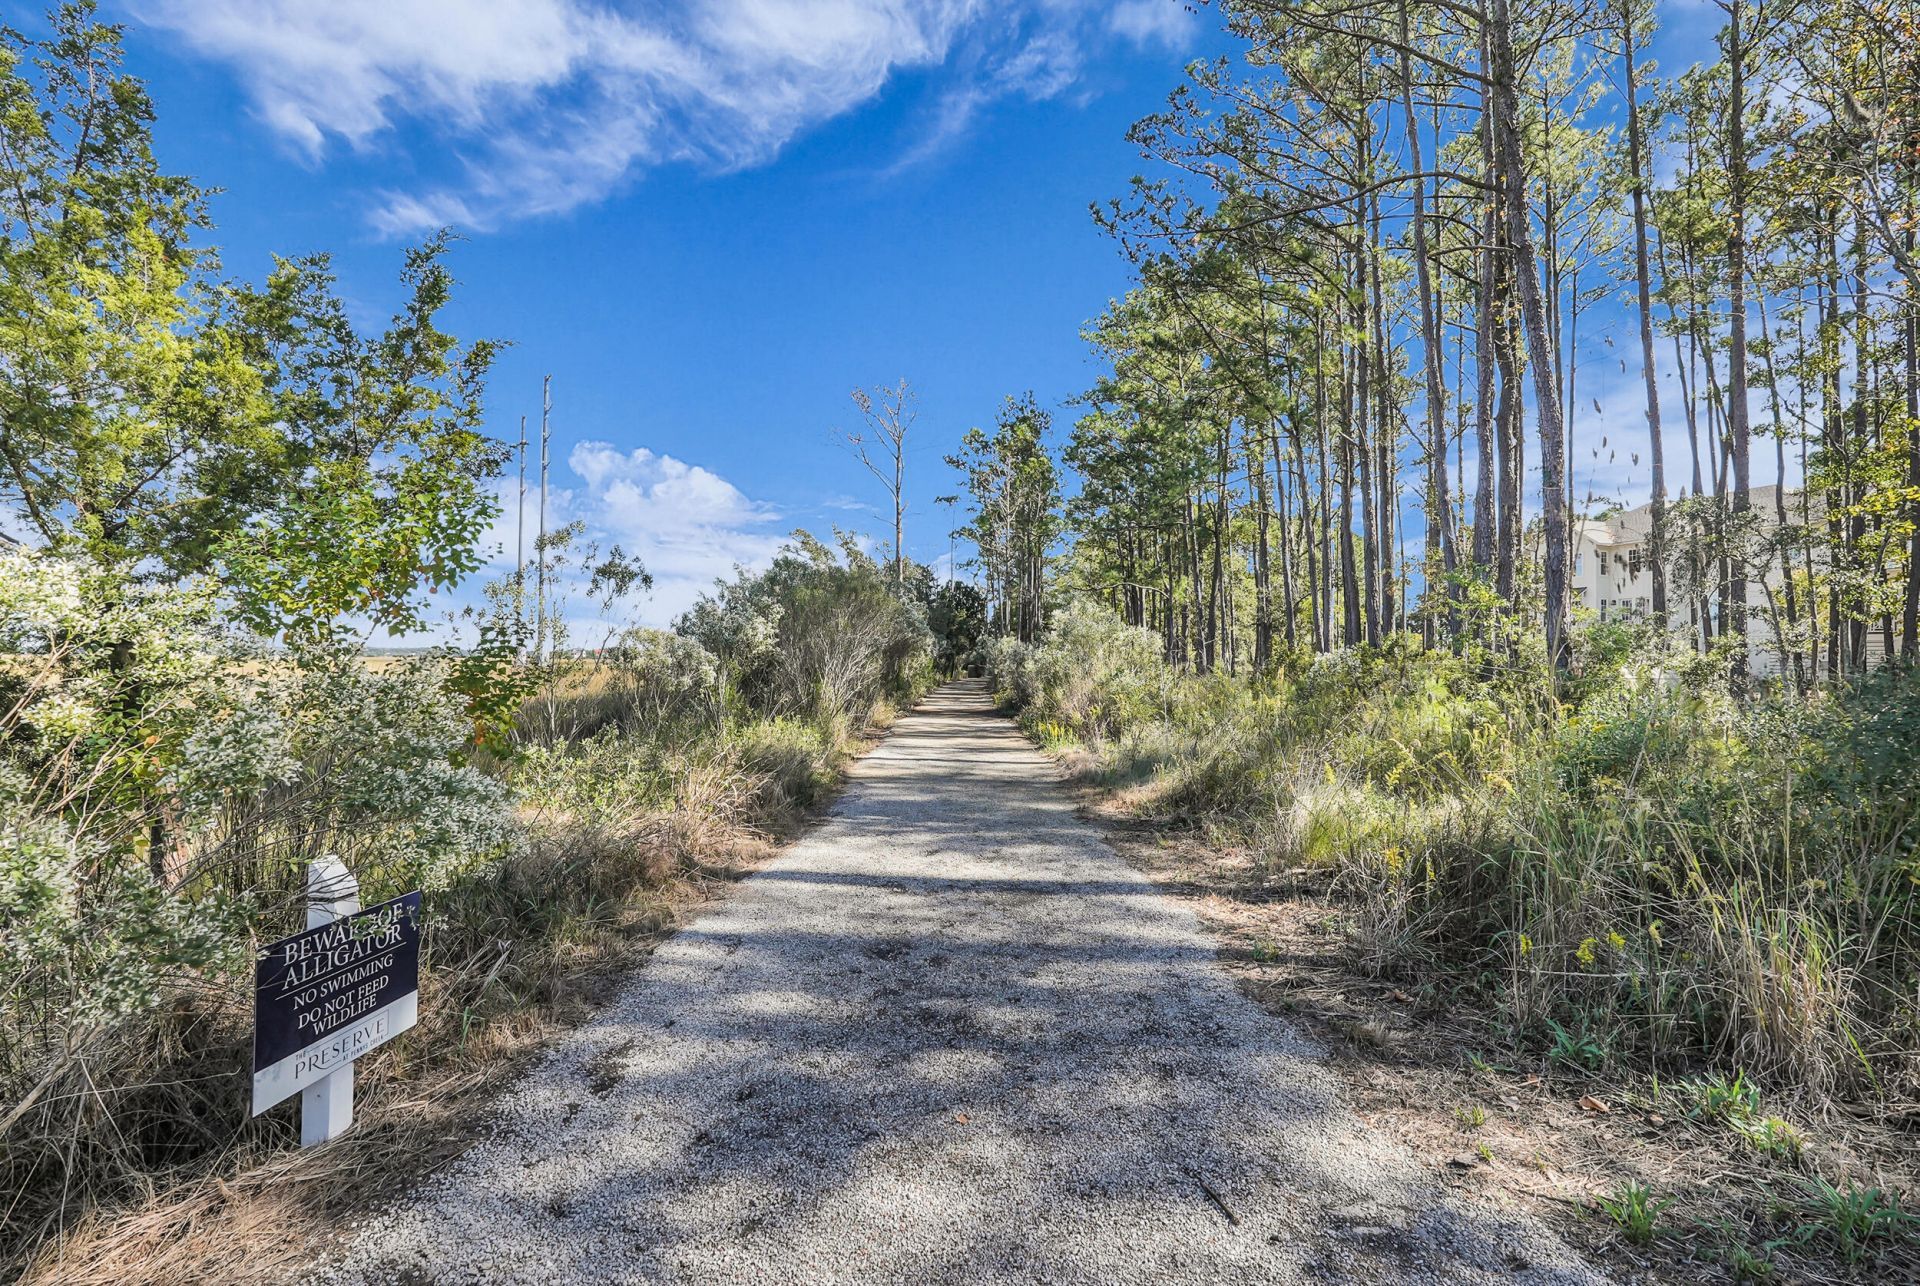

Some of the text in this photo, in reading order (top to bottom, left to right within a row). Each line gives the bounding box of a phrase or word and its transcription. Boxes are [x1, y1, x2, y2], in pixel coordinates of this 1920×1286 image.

[282, 924, 402, 991] ALLIGATOR
[284, 903, 403, 966] BEWA OF
[293, 953, 393, 1010] NO SWIMMING
[298, 975, 389, 1030] DO NOT FEED
[313, 993, 377, 1035] WILDLIFE
[294, 1017, 385, 1080] PRESERVE
